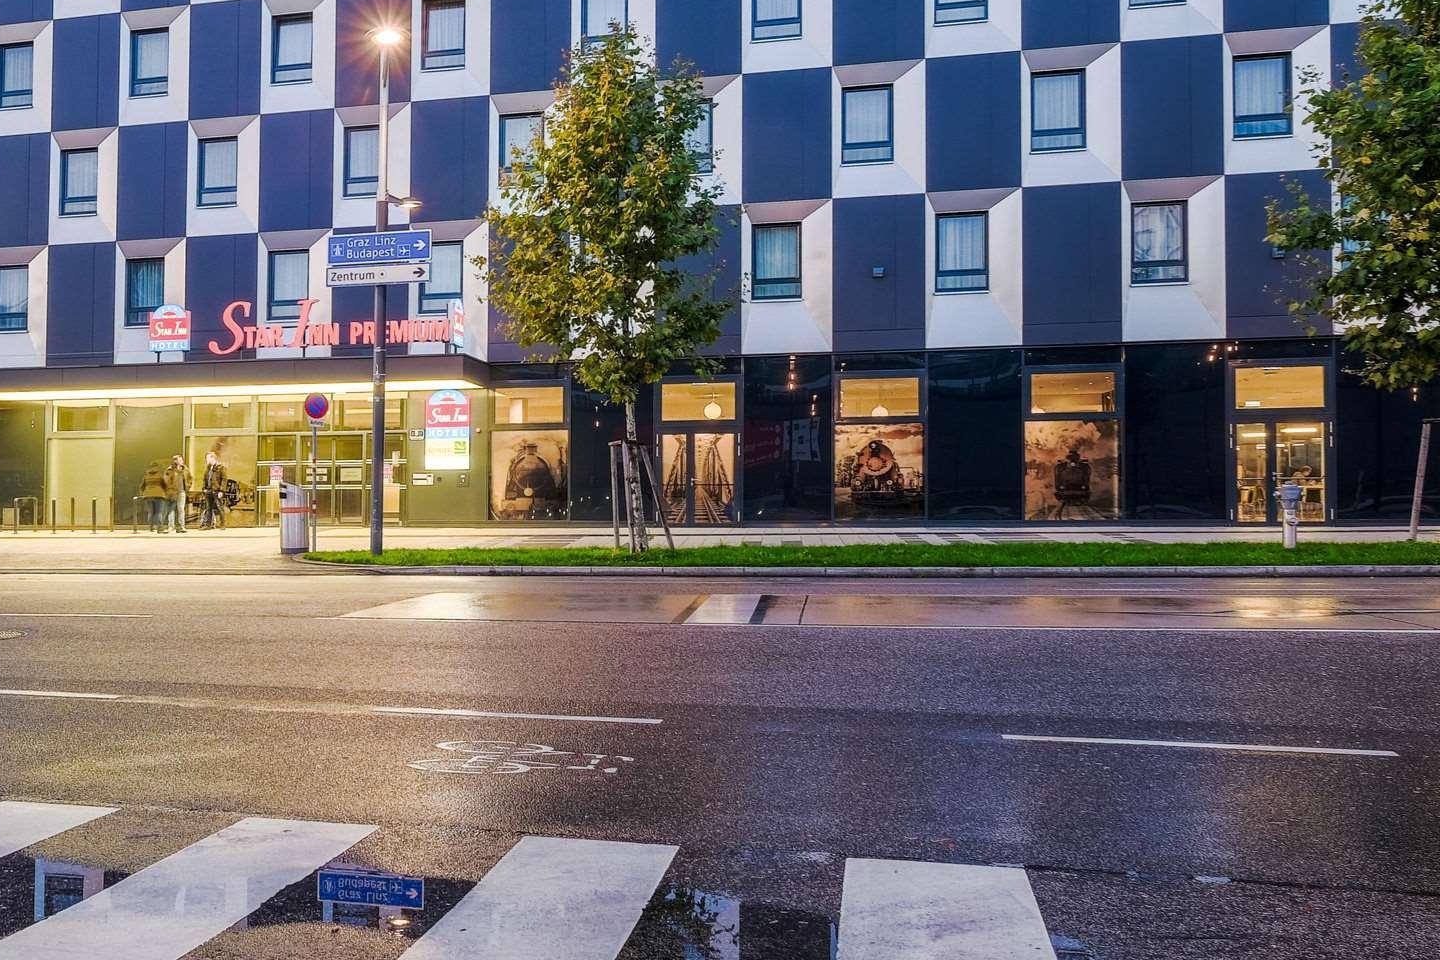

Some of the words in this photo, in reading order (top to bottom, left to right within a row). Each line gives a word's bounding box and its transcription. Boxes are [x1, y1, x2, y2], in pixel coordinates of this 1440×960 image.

[347, 238, 370, 248] Graz
[375, 235, 396, 246] Linz
[347, 247, 394, 259] Budapest
[331, 271, 374, 282] Zentrum
[350, 320, 449, 345] PRMIUM
[151, 342, 185, 350] HOTEL
[428, 429, 467, 439] HOTEL
